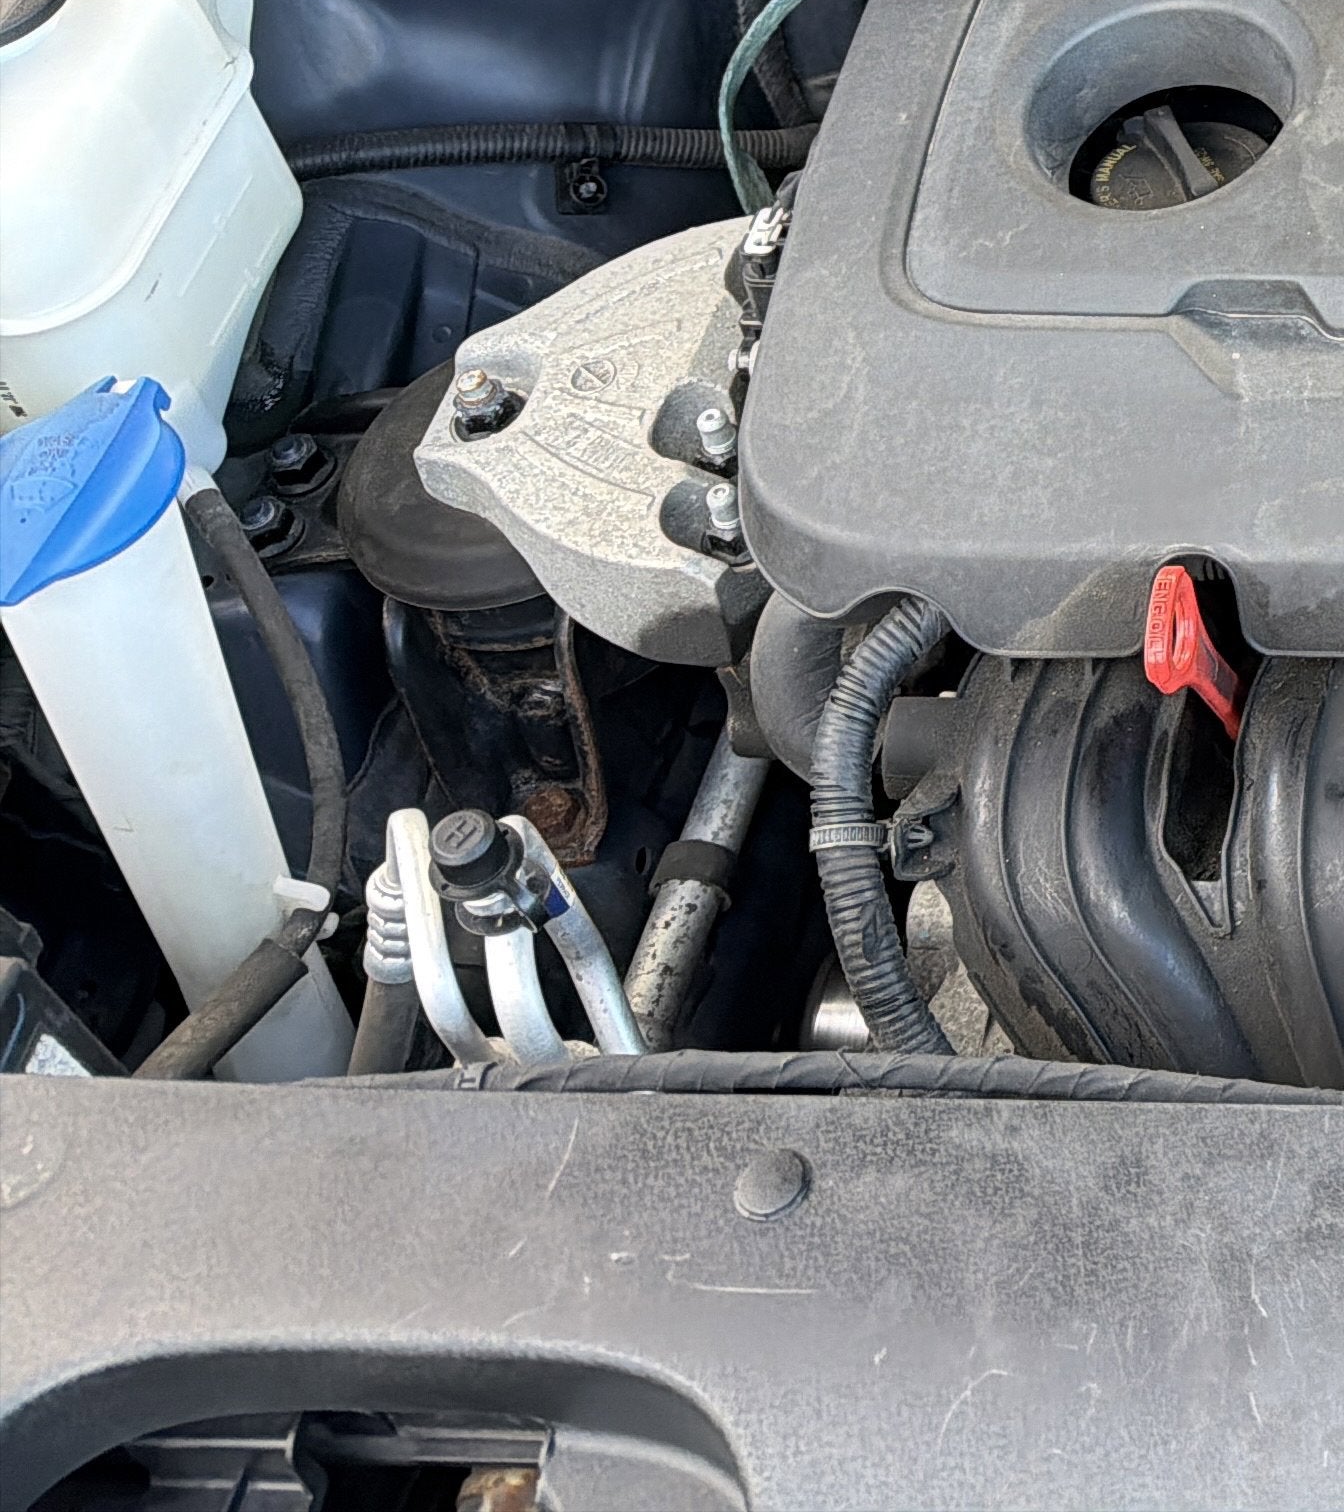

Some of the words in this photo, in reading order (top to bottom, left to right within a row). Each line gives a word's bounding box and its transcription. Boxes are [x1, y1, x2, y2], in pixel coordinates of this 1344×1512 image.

[1095, 143, 1137, 182] MANUAL
[1150, 577, 1172, 617] ENG
[1146, 618, 1167, 665] OIL
